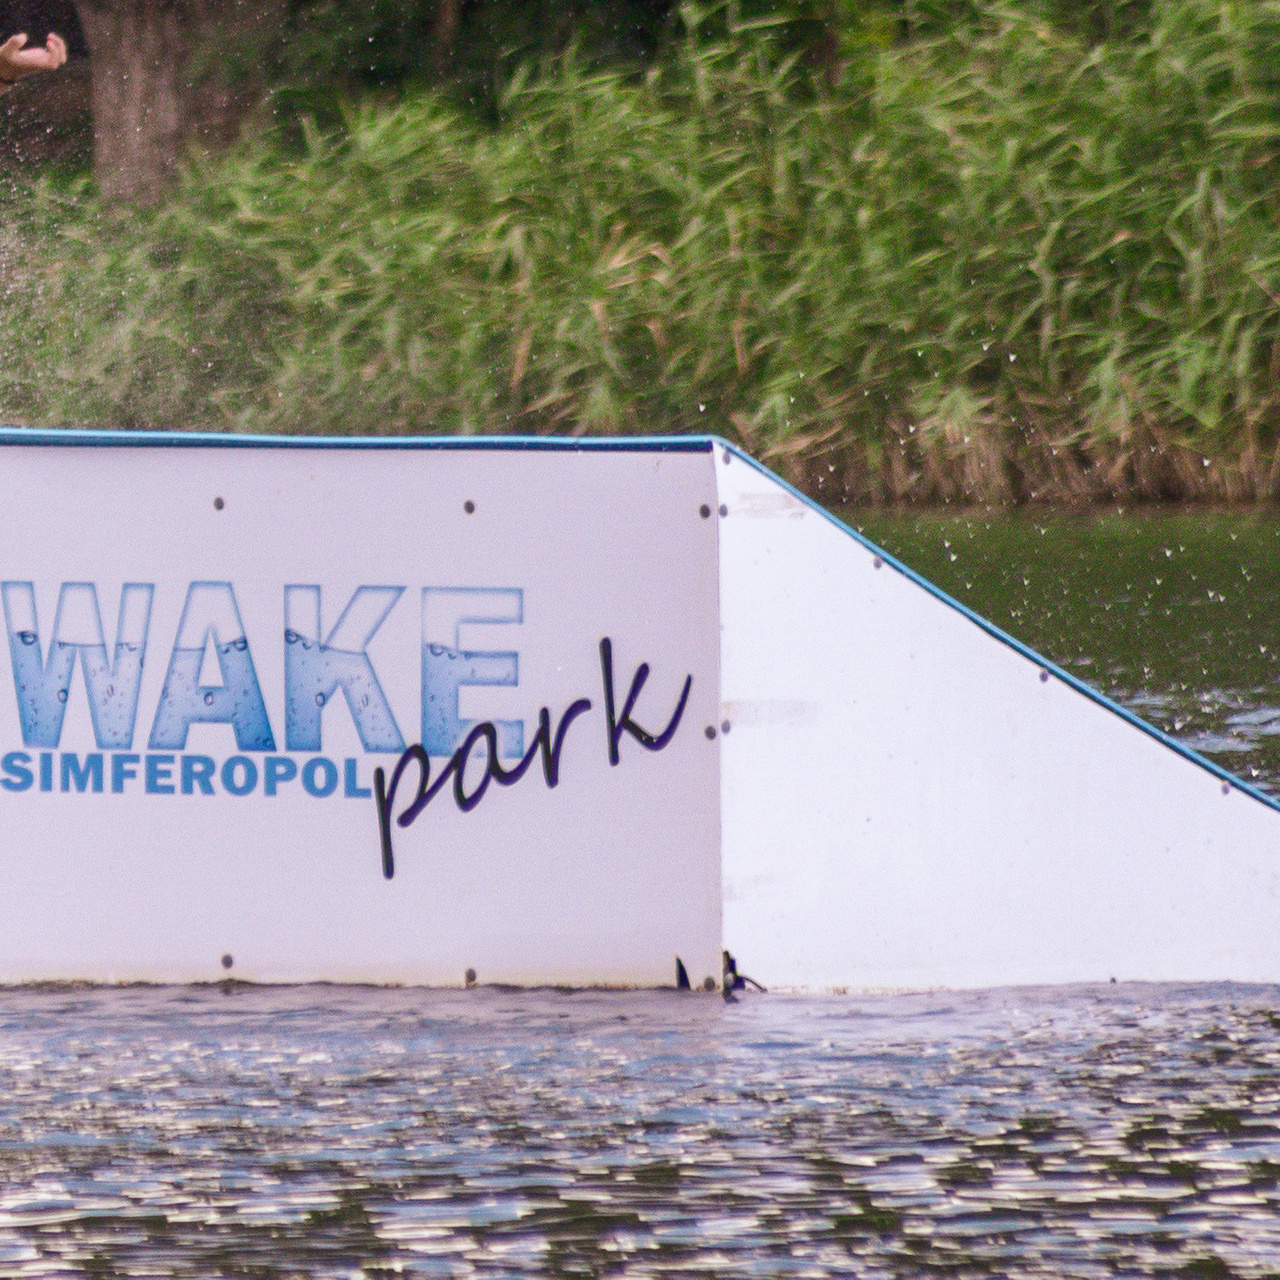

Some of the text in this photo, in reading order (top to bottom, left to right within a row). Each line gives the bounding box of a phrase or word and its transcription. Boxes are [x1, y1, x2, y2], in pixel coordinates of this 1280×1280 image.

[0, 581, 524, 758] WAKE
[374, 636, 693, 880] park
[0, 751, 372, 799] SIMFEROPOL
